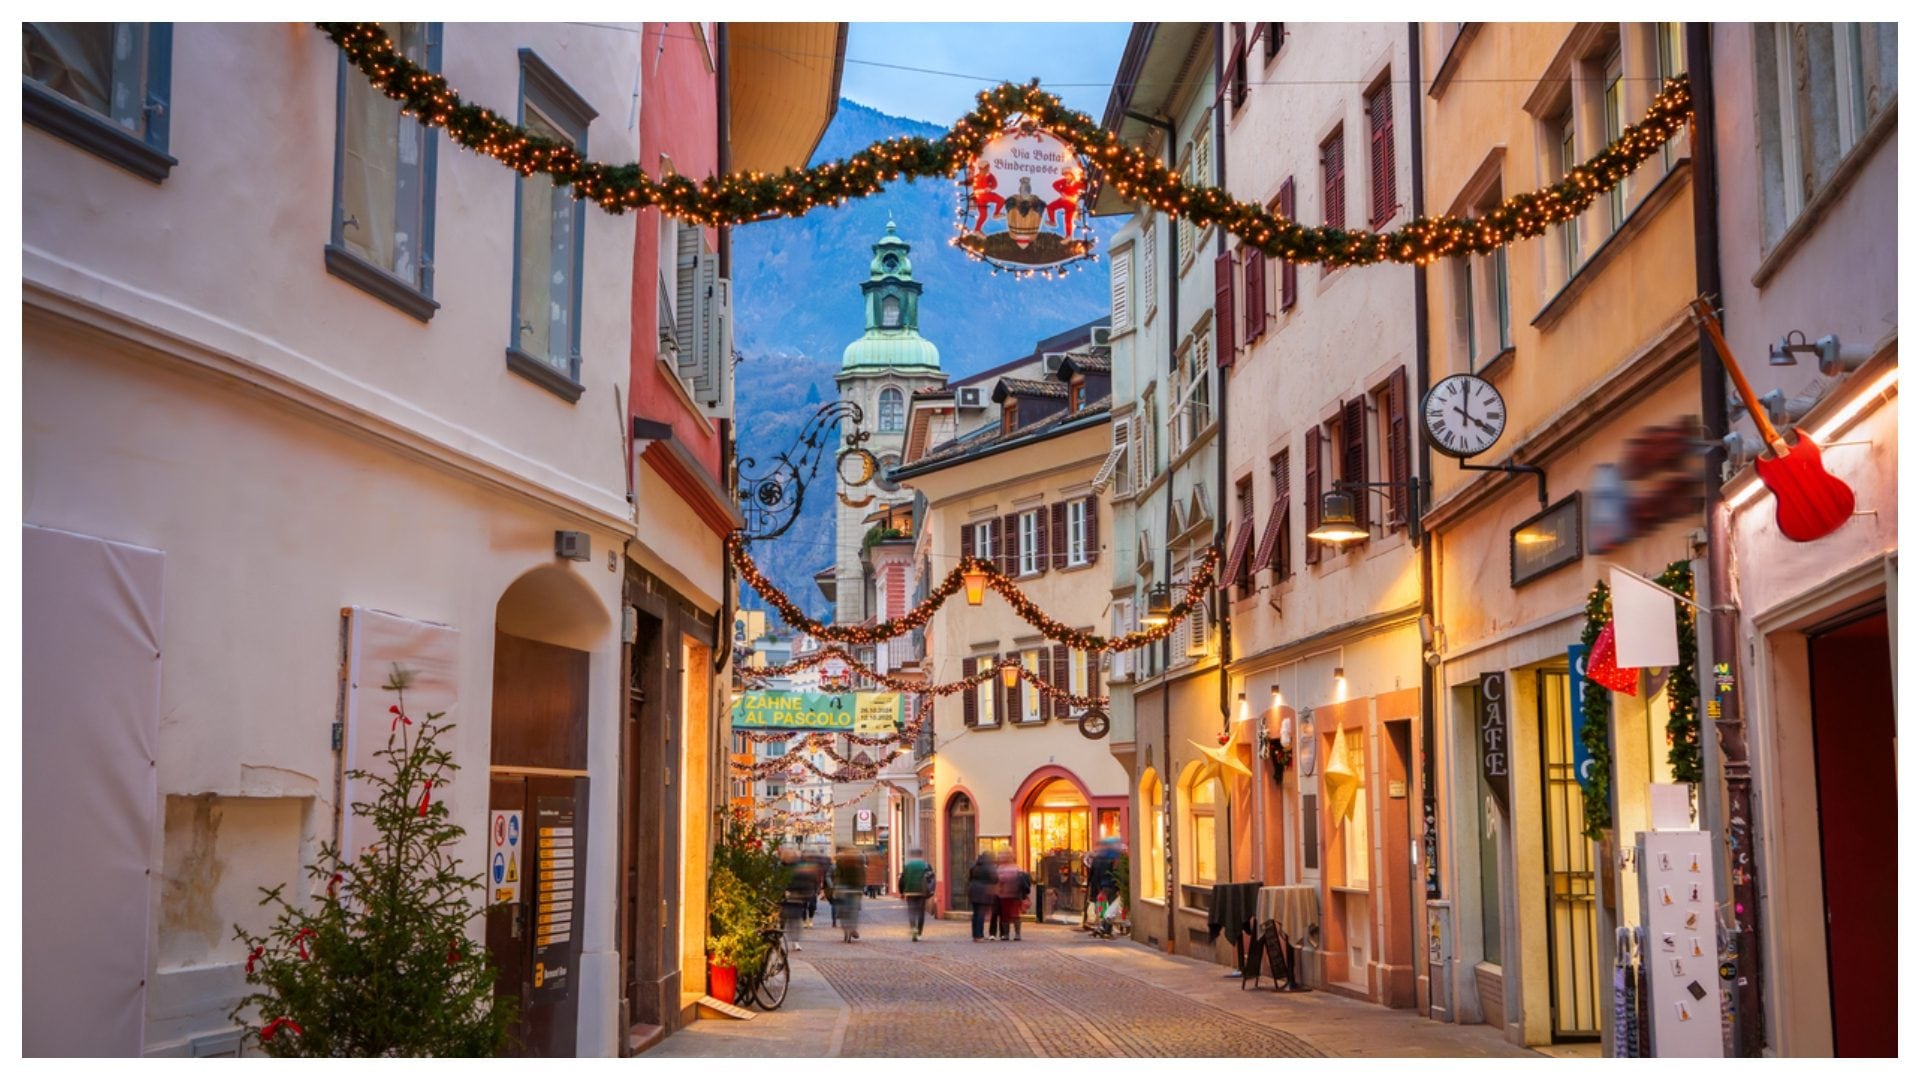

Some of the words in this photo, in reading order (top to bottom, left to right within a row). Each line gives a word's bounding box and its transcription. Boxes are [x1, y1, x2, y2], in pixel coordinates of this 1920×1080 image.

[1010, 147, 1030, 159] Via
[993, 158, 1058, 175] Bindergasse
[744, 711, 768, 725] AL
[772, 711, 851, 726] PASCOLO
[1482, 674, 1507, 776] CAFE
